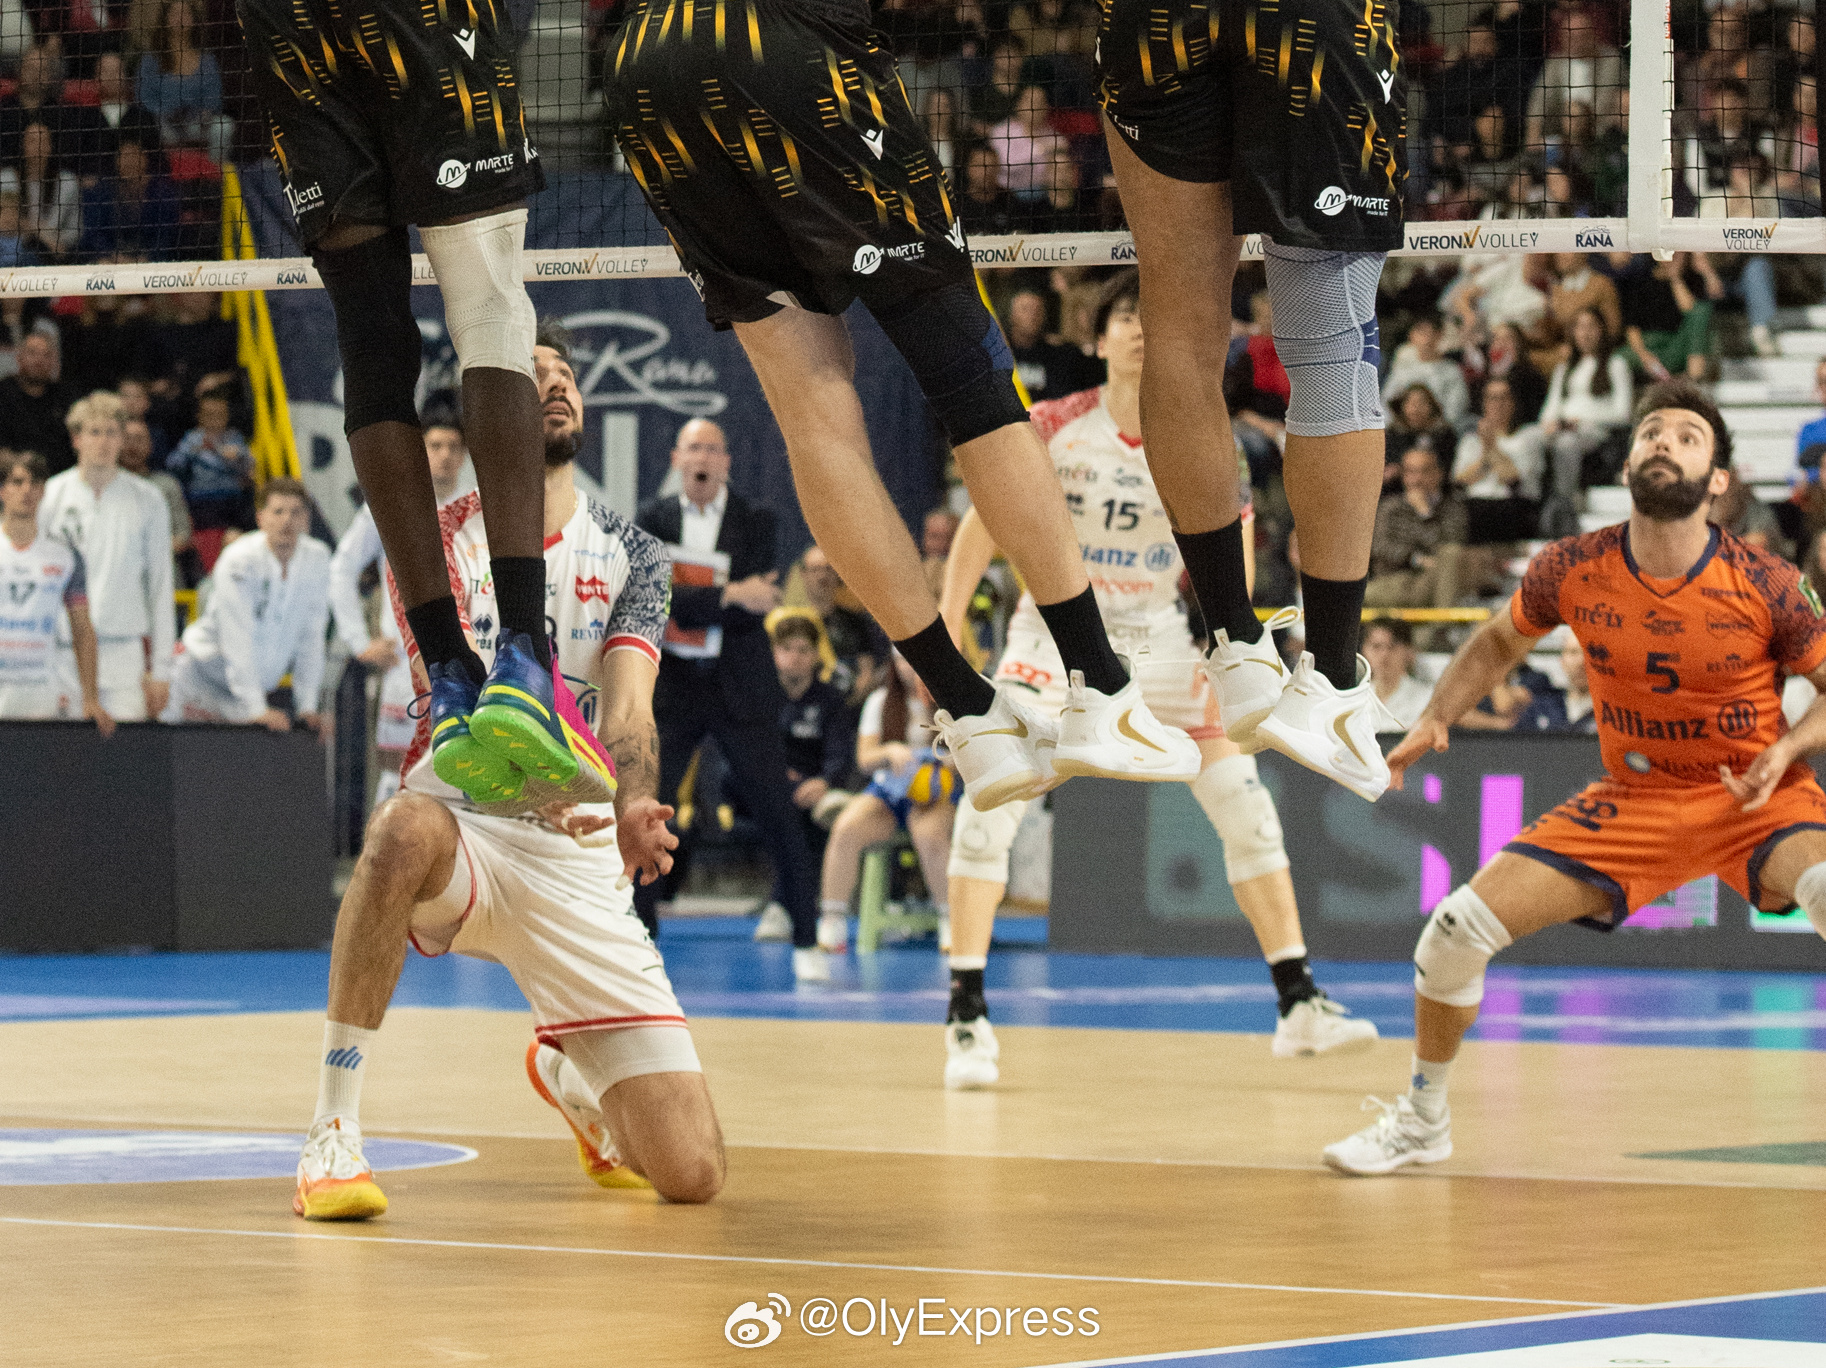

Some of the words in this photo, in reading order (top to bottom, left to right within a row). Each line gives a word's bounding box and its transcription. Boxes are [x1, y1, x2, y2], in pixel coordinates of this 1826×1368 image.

[1479, 232, 1539, 248] VOLLEY
[1575, 233, 1614, 248] RANA
[1725, 239, 1771, 250] VOLLEY
[1022, 246, 1077, 261] VOLLEY
[1111, 246, 1138, 260] RAN
[597, 258, 648, 274] VOLLEY
[11, 277, 59, 292] VOLLEY
[86, 278, 115, 291] RANA
[200, 271, 248, 287] VOLLEY
[276, 272, 308, 285] RANA
[1102, 498, 1144, 530] 15
[1646, 651, 1681, 694] 5
[1601, 701, 1710, 741] Allianz
